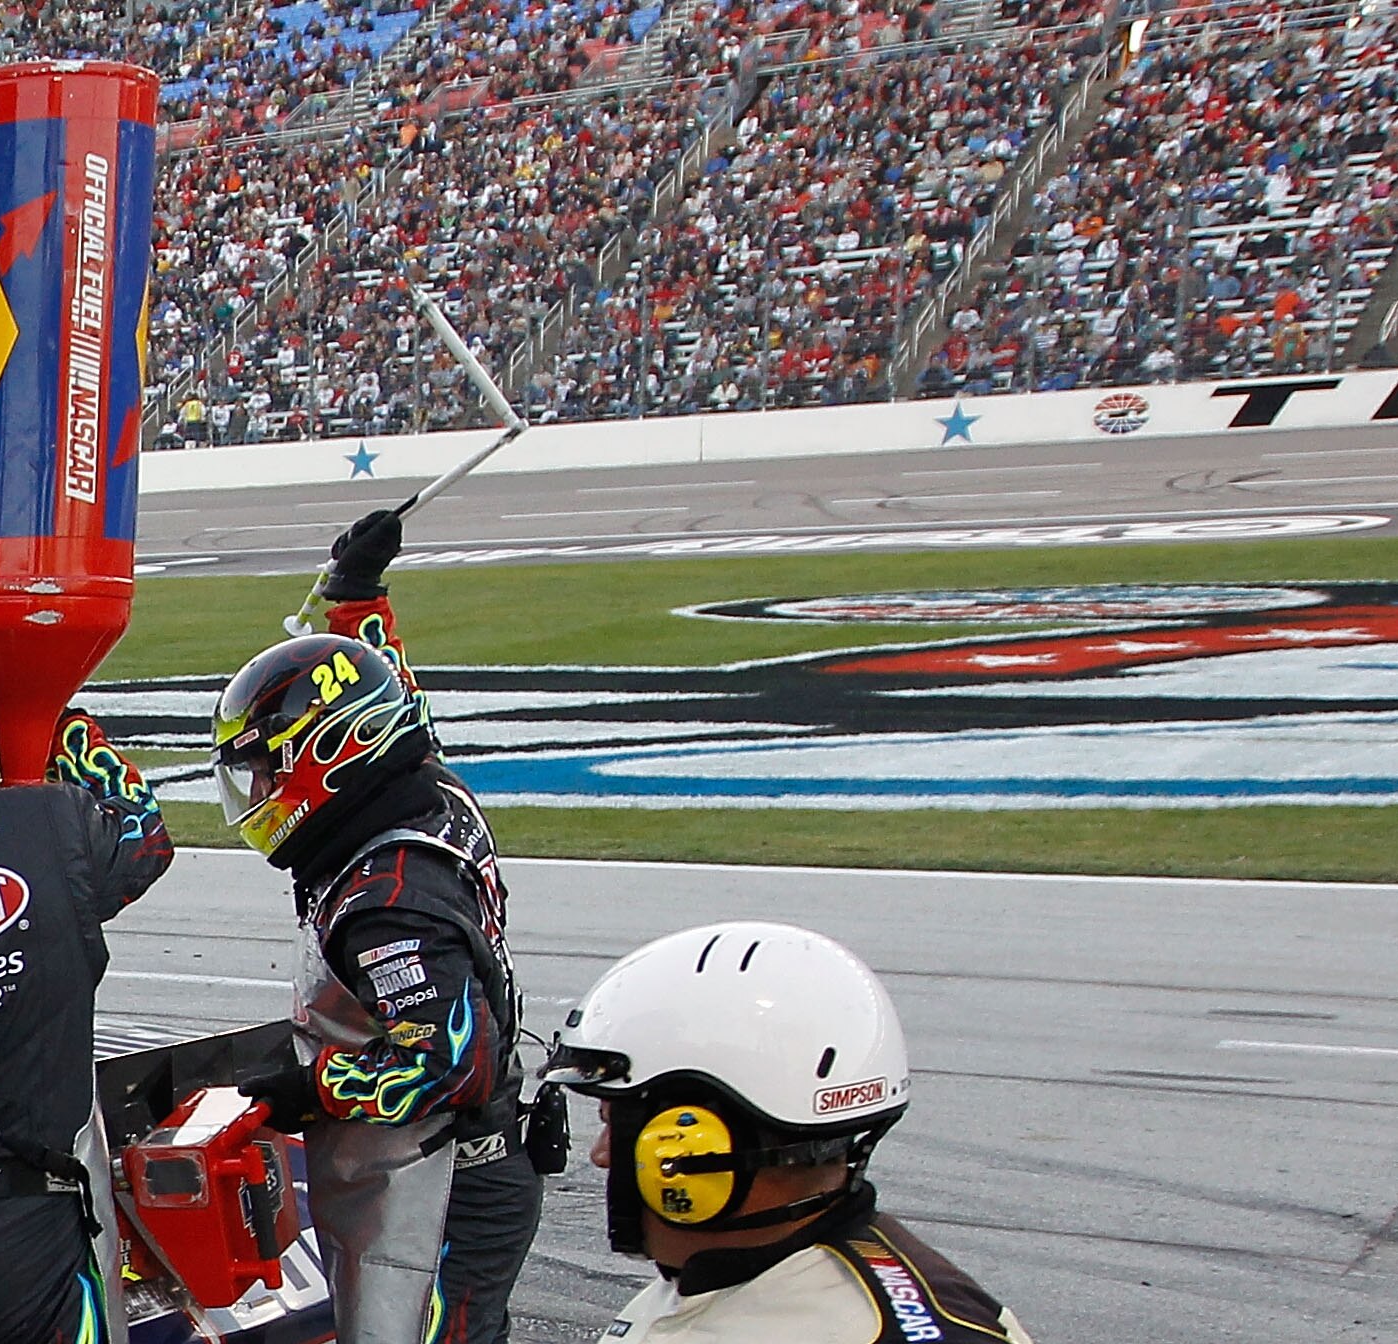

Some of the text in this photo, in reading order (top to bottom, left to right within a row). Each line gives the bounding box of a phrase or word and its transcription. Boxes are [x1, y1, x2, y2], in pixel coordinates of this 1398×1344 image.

[81, 152, 108, 332] OFFICIAL FUEL
[66, 384, 99, 503] NASCAR
[311, 651, 360, 705] 24
[395, 985, 439, 1011] pepsi
[818, 1081, 884, 1112] SIMPSON
[872, 1264, 944, 1343] NASCAR
